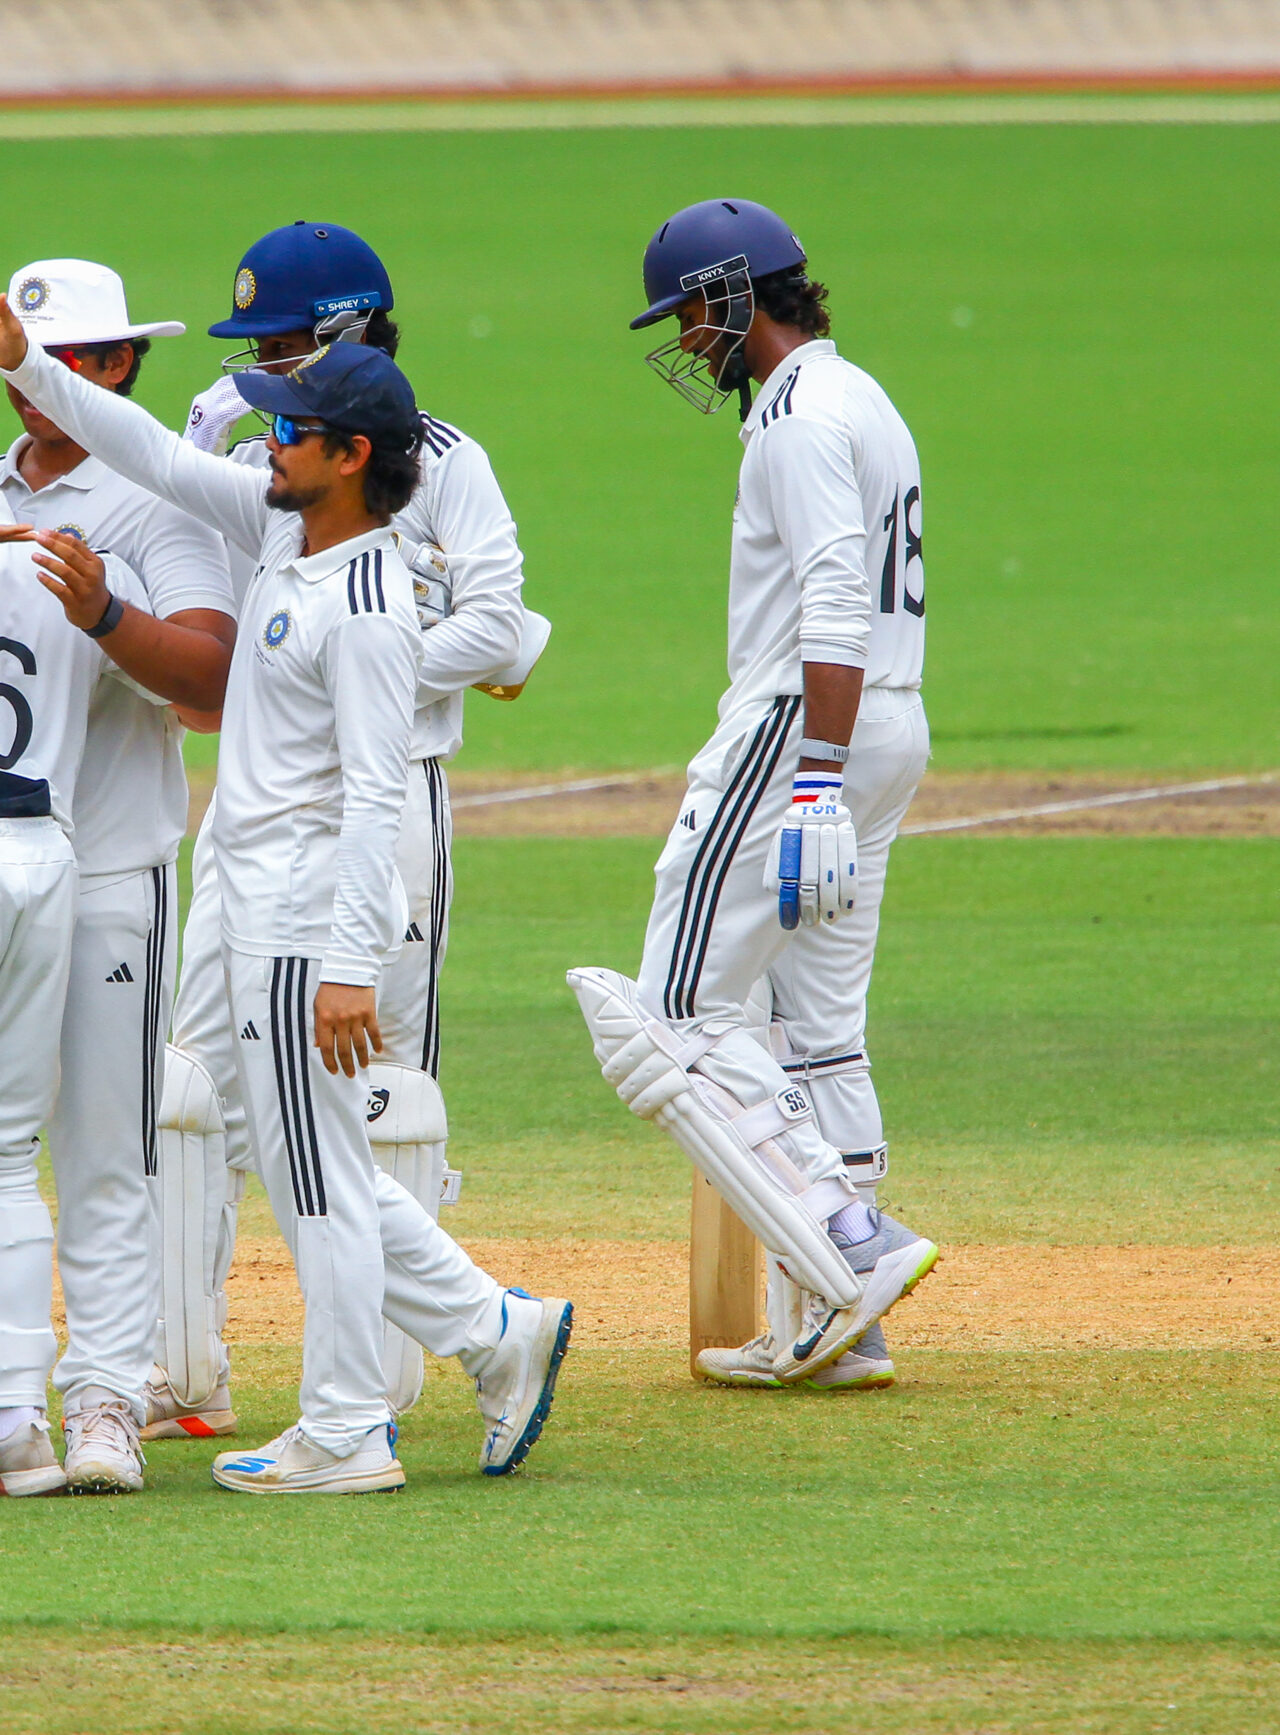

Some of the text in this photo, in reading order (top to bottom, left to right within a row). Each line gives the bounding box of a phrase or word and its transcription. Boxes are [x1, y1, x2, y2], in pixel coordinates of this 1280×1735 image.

[697, 266, 725, 282] KNYX
[328, 299, 359, 312] SHREY
[880, 482, 925, 618] 18
[801, 804, 837, 816] TON
[784, 1090, 807, 1112] SS
